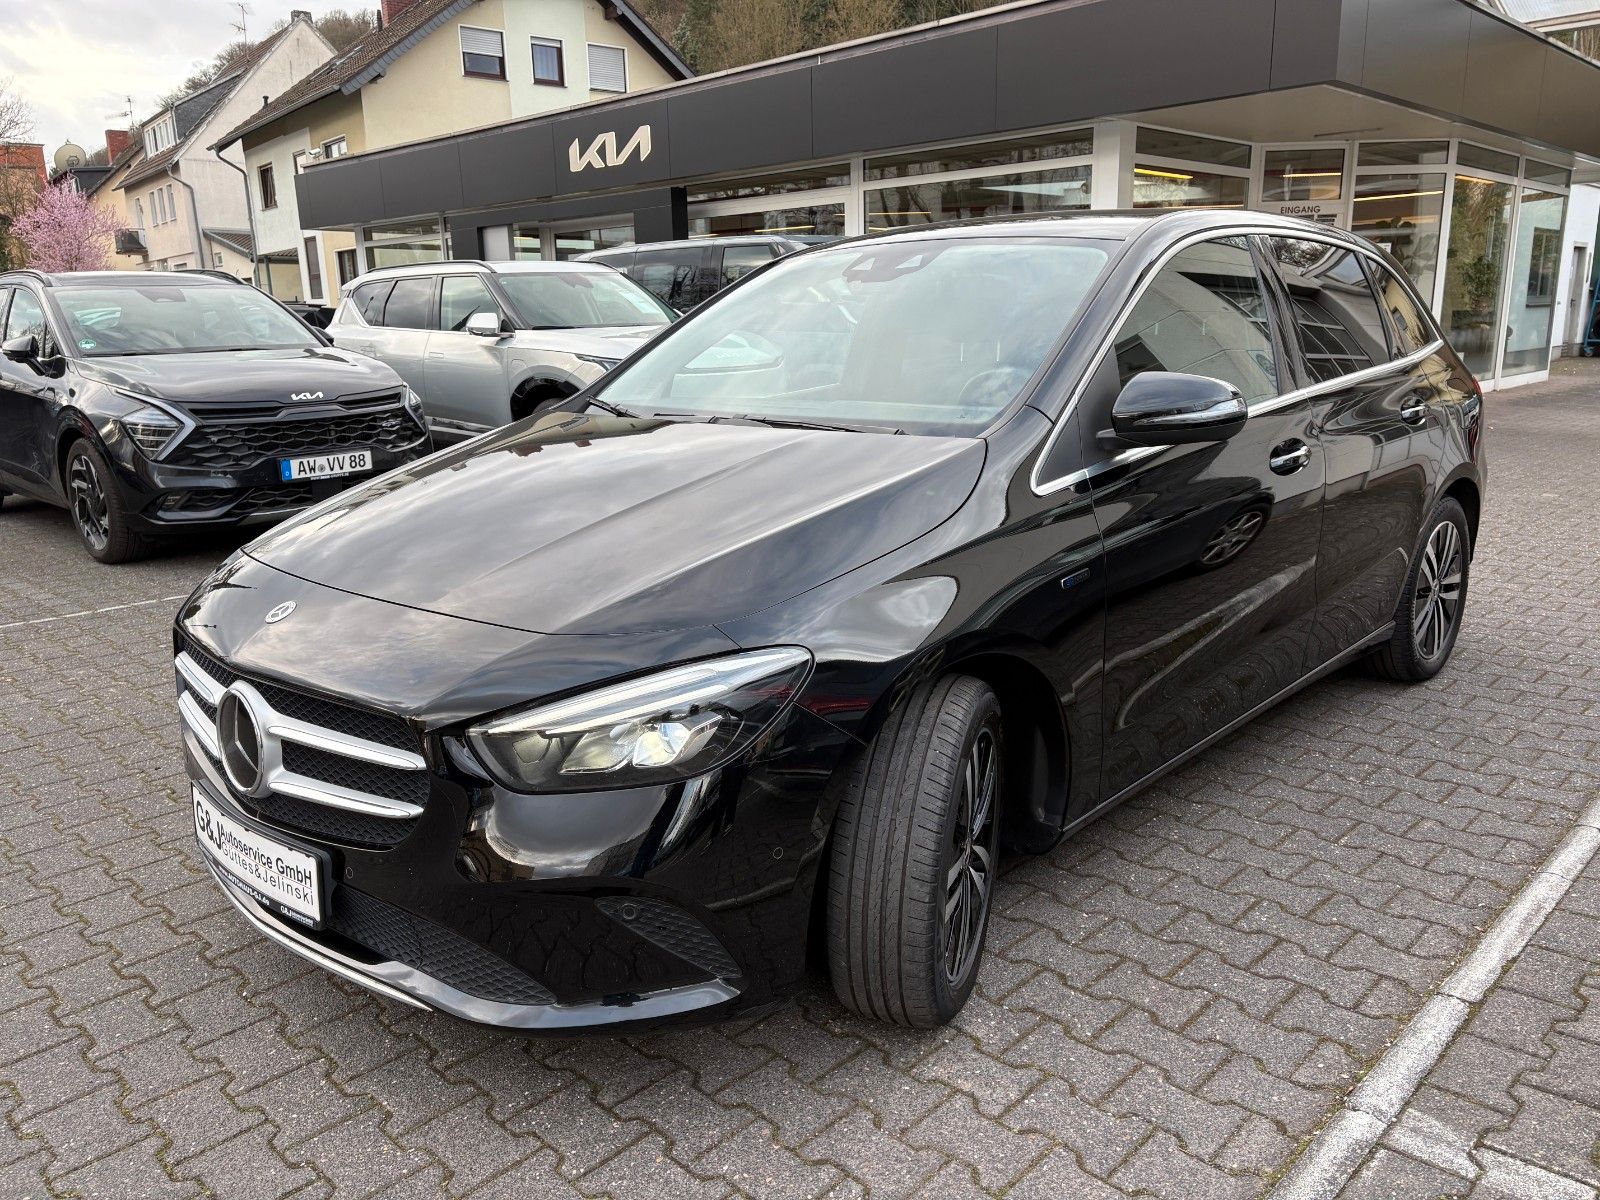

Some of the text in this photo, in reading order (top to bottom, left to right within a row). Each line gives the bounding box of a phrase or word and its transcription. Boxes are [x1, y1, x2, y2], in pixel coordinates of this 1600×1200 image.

[569, 125, 651, 172] KIA
[1280, 205, 1320, 214] EINGANG
[298, 454, 366, 475] AW VV 88
[196, 800, 221, 850] G&J
[221, 823, 312, 888] Autoservice GmbH
